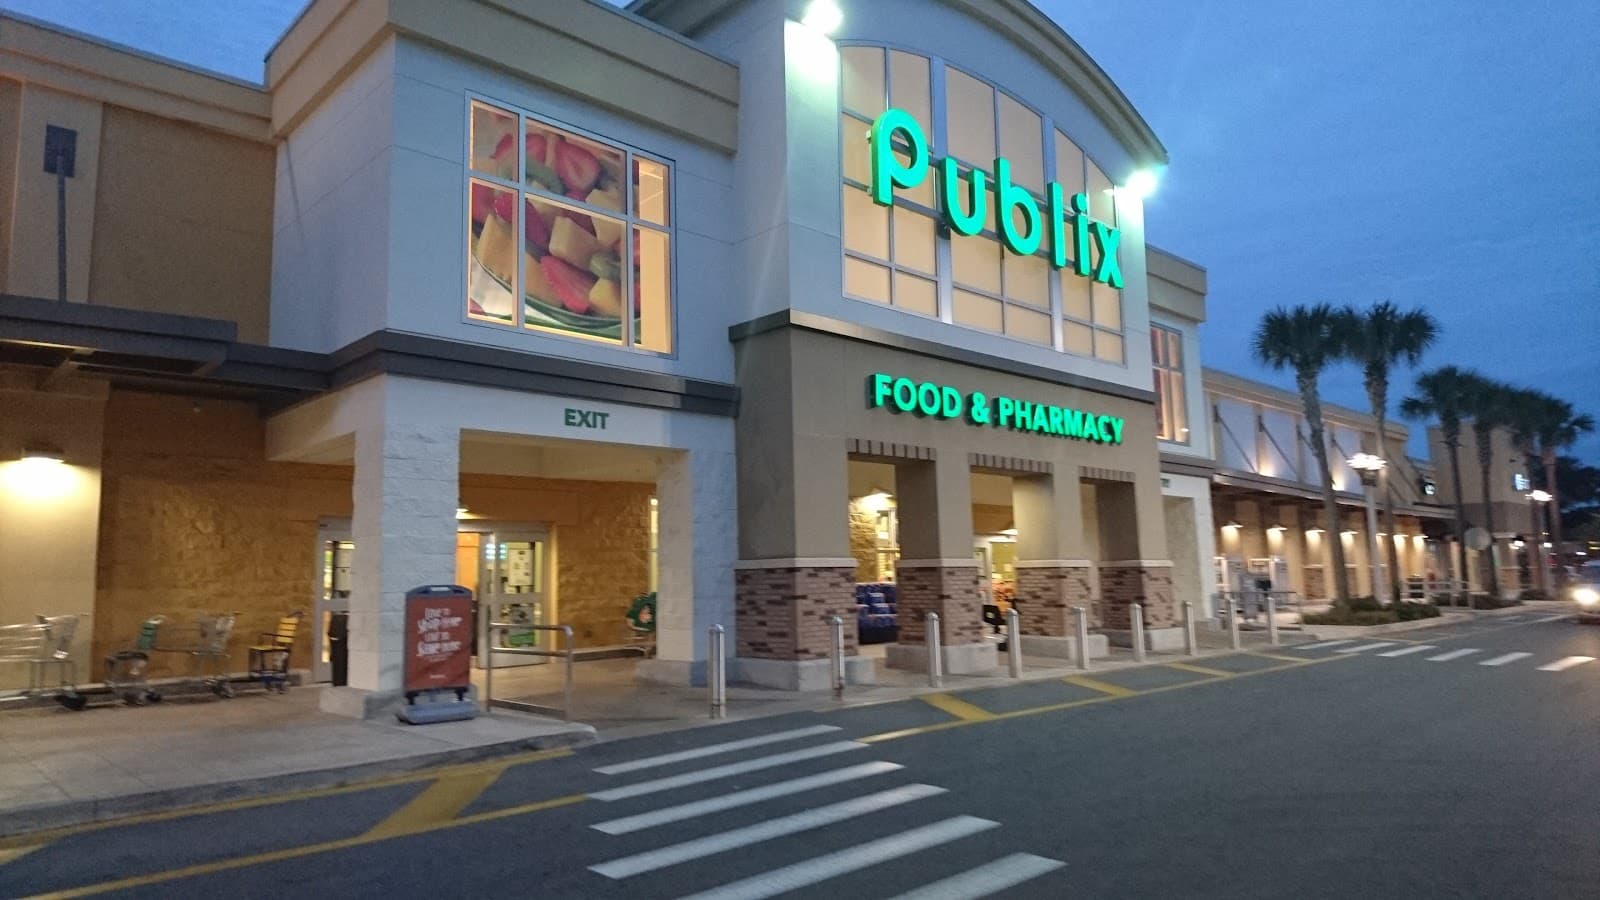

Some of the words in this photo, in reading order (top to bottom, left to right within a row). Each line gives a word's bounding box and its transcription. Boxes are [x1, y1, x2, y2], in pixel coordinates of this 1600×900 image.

[871, 108, 1124, 289] Publix
[564, 407, 610, 430] EXIT
[872, 373, 962, 418] FOOD
[969, 392, 991, 425] &
[997, 397, 1125, 444] PHARMACY
